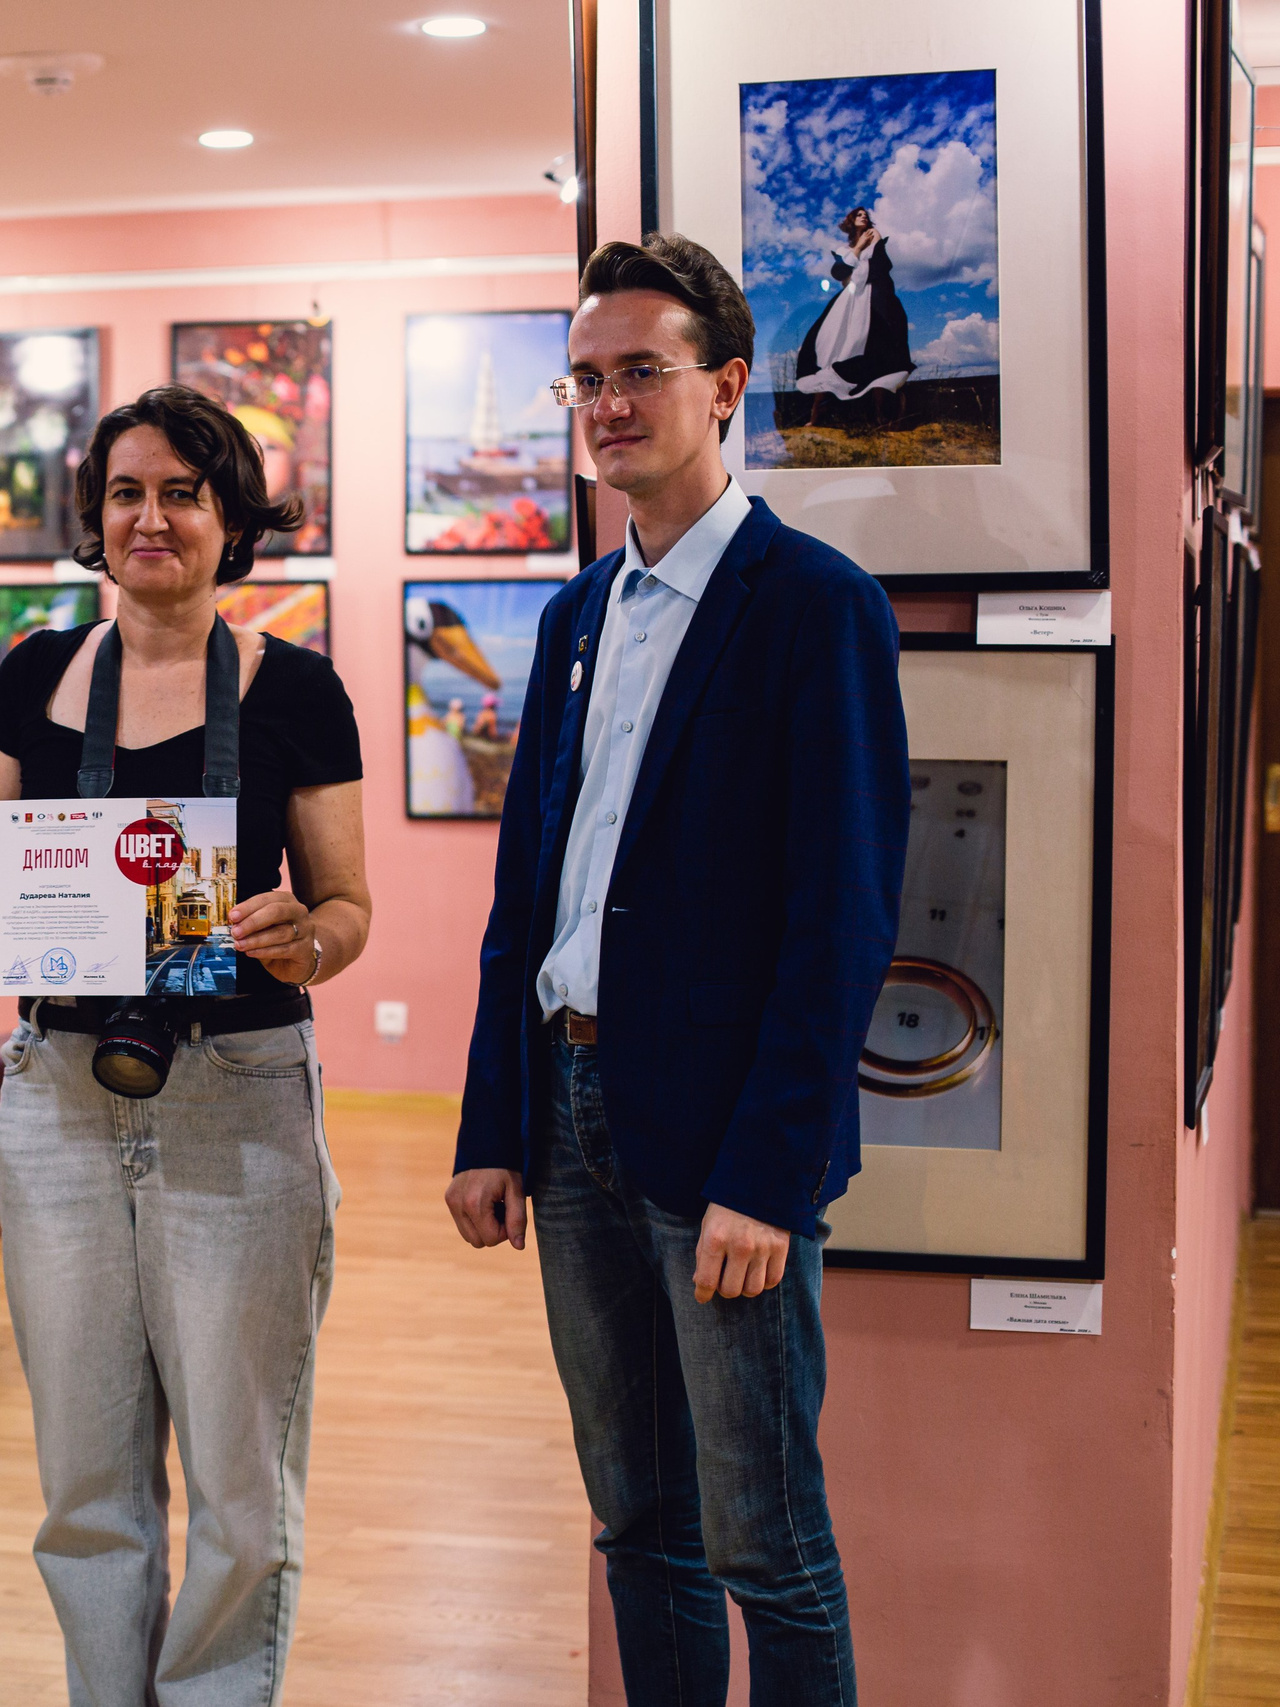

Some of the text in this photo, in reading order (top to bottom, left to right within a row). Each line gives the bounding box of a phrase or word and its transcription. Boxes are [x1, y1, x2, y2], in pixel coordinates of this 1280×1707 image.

[120, 834, 176, 862] ЦВЕТ
[23, 848, 89, 871] ДИПЛОМ
[19, 892, 57, 900] Дударева
[929, 908, 947, 921] 11
[897, 1012, 920, 1029] 18
